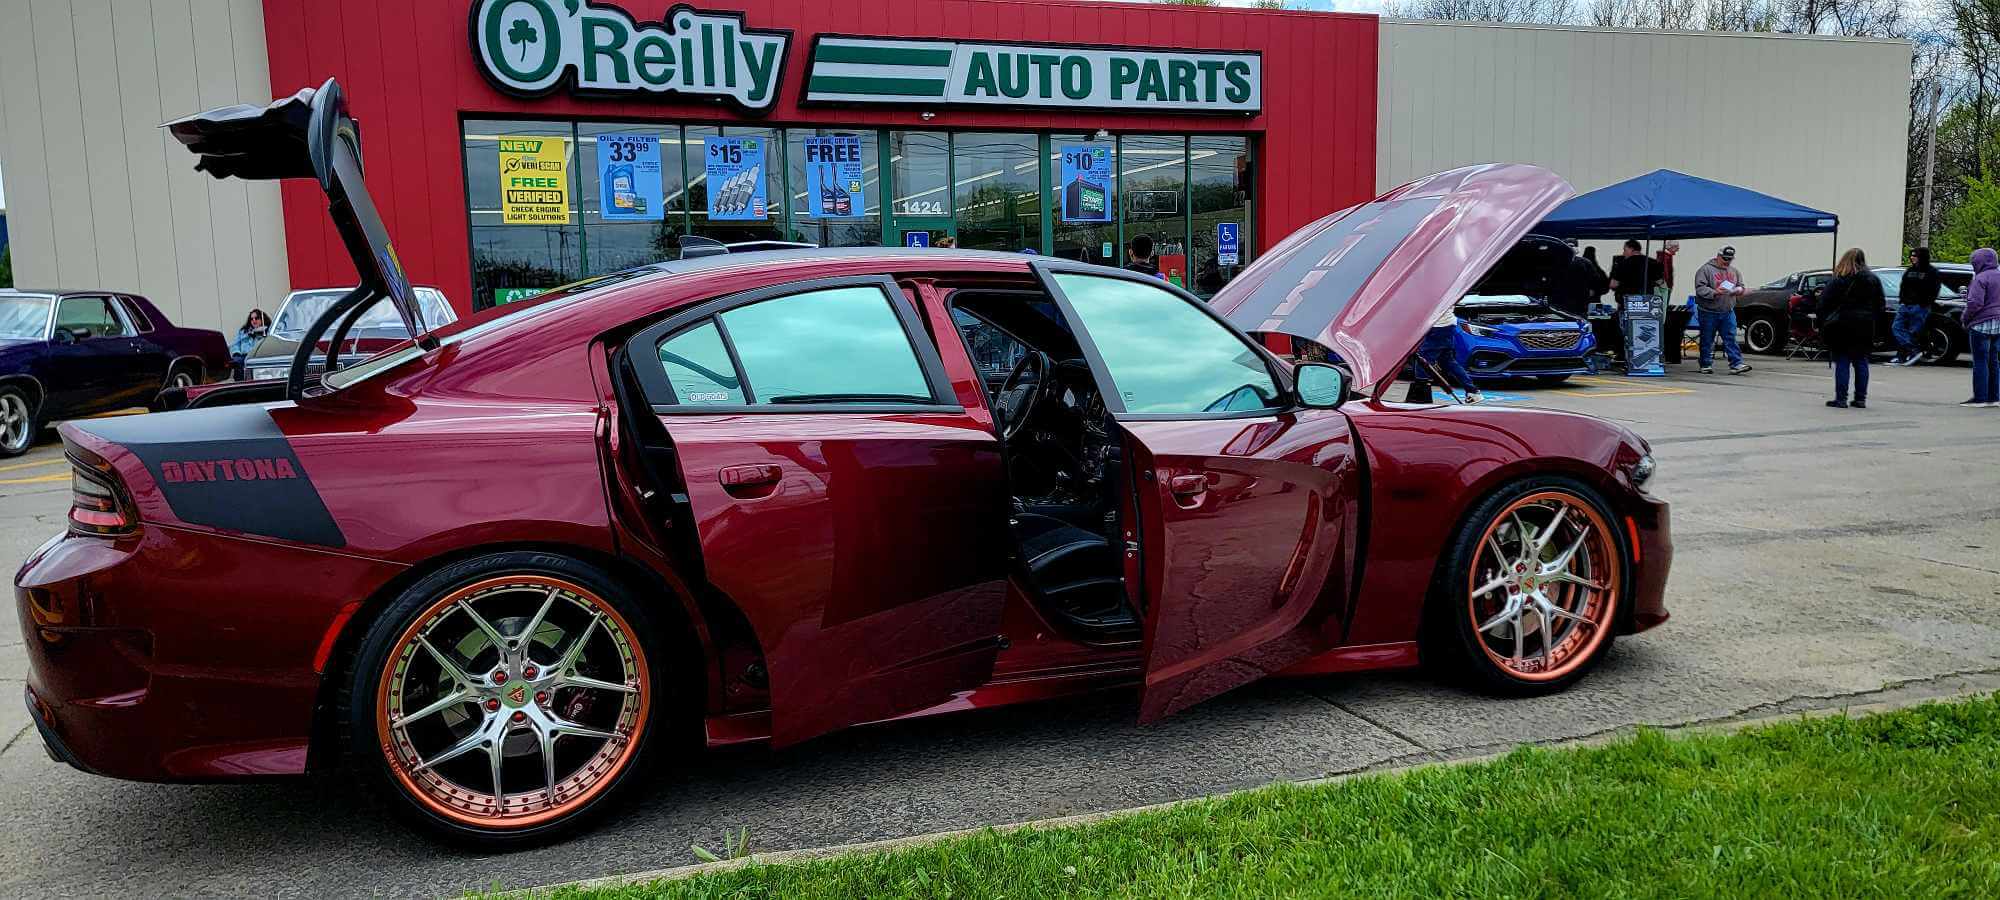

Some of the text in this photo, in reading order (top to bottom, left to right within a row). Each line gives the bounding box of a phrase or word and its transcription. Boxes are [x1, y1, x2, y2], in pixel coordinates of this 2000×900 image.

[485, 0, 779, 101] O'Reilly
[963, 51, 1251, 103] AUTO PARTS
[500, 141, 538, 151] NEW
[711, 144, 741, 164] $15
[806, 145, 861, 162] FREE
[1066, 153, 1093, 170] $10
[511, 178, 558, 188] FREE
[509, 191, 562, 203] VERIFIED
[903, 201, 942, 214] 1424
[160, 458, 297, 483] DAYTONA
